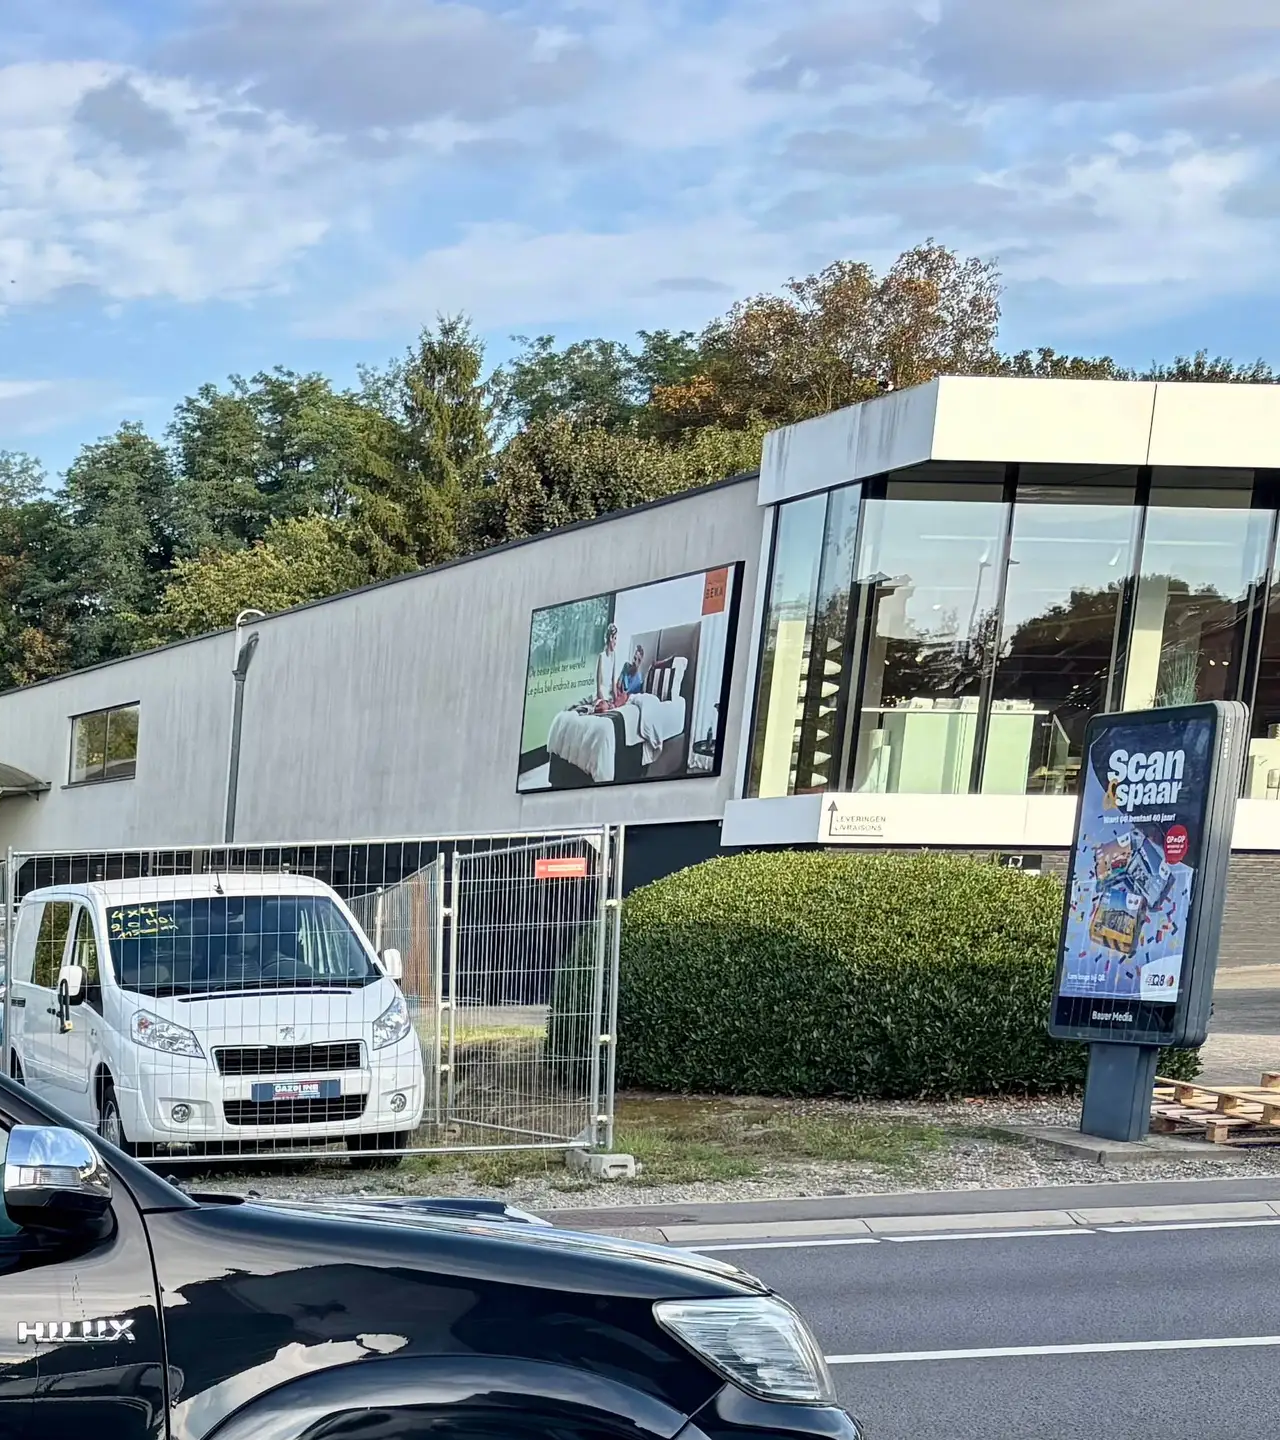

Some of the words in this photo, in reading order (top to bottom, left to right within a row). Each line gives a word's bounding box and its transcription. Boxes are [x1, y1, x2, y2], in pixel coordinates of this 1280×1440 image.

[1107, 749, 1185, 782] Scan
[1115, 781, 1182, 812] spaar
[1092, 1010, 1112, 1021] Bauer
[1112, 1011, 1133, 1023] Media
[17, 1319, 136, 1345] HILUX
